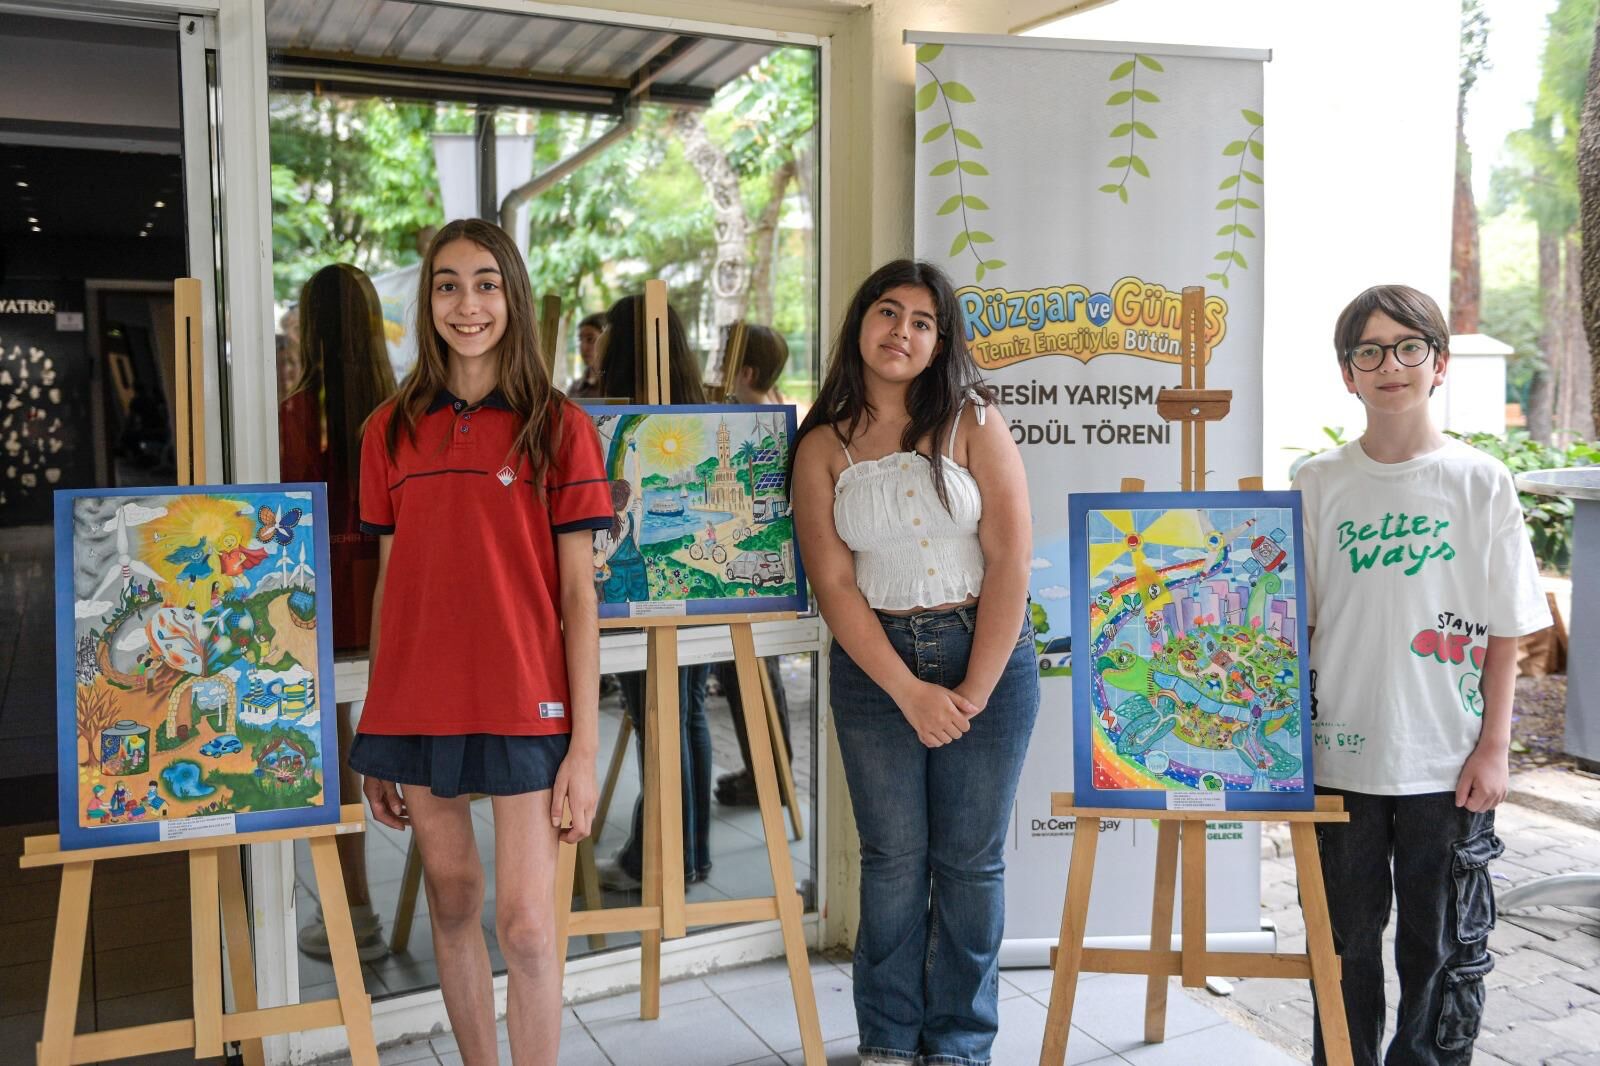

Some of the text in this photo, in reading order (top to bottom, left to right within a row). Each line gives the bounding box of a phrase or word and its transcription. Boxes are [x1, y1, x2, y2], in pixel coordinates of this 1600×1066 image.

[959, 281, 1223, 343] Rüzgar ve Günş
[977, 335, 1031, 363] Temiz
[1034, 326, 1120, 355] Enerjiyle
[986, 380, 1057, 405] RESİM
[1009, 419, 1170, 445] ÖDÜL TÖRENİ
[1337, 512, 1450, 550] Better
[1206, 832, 1244, 840] GELECEK
[1218, 822, 1243, 830] NEFES
